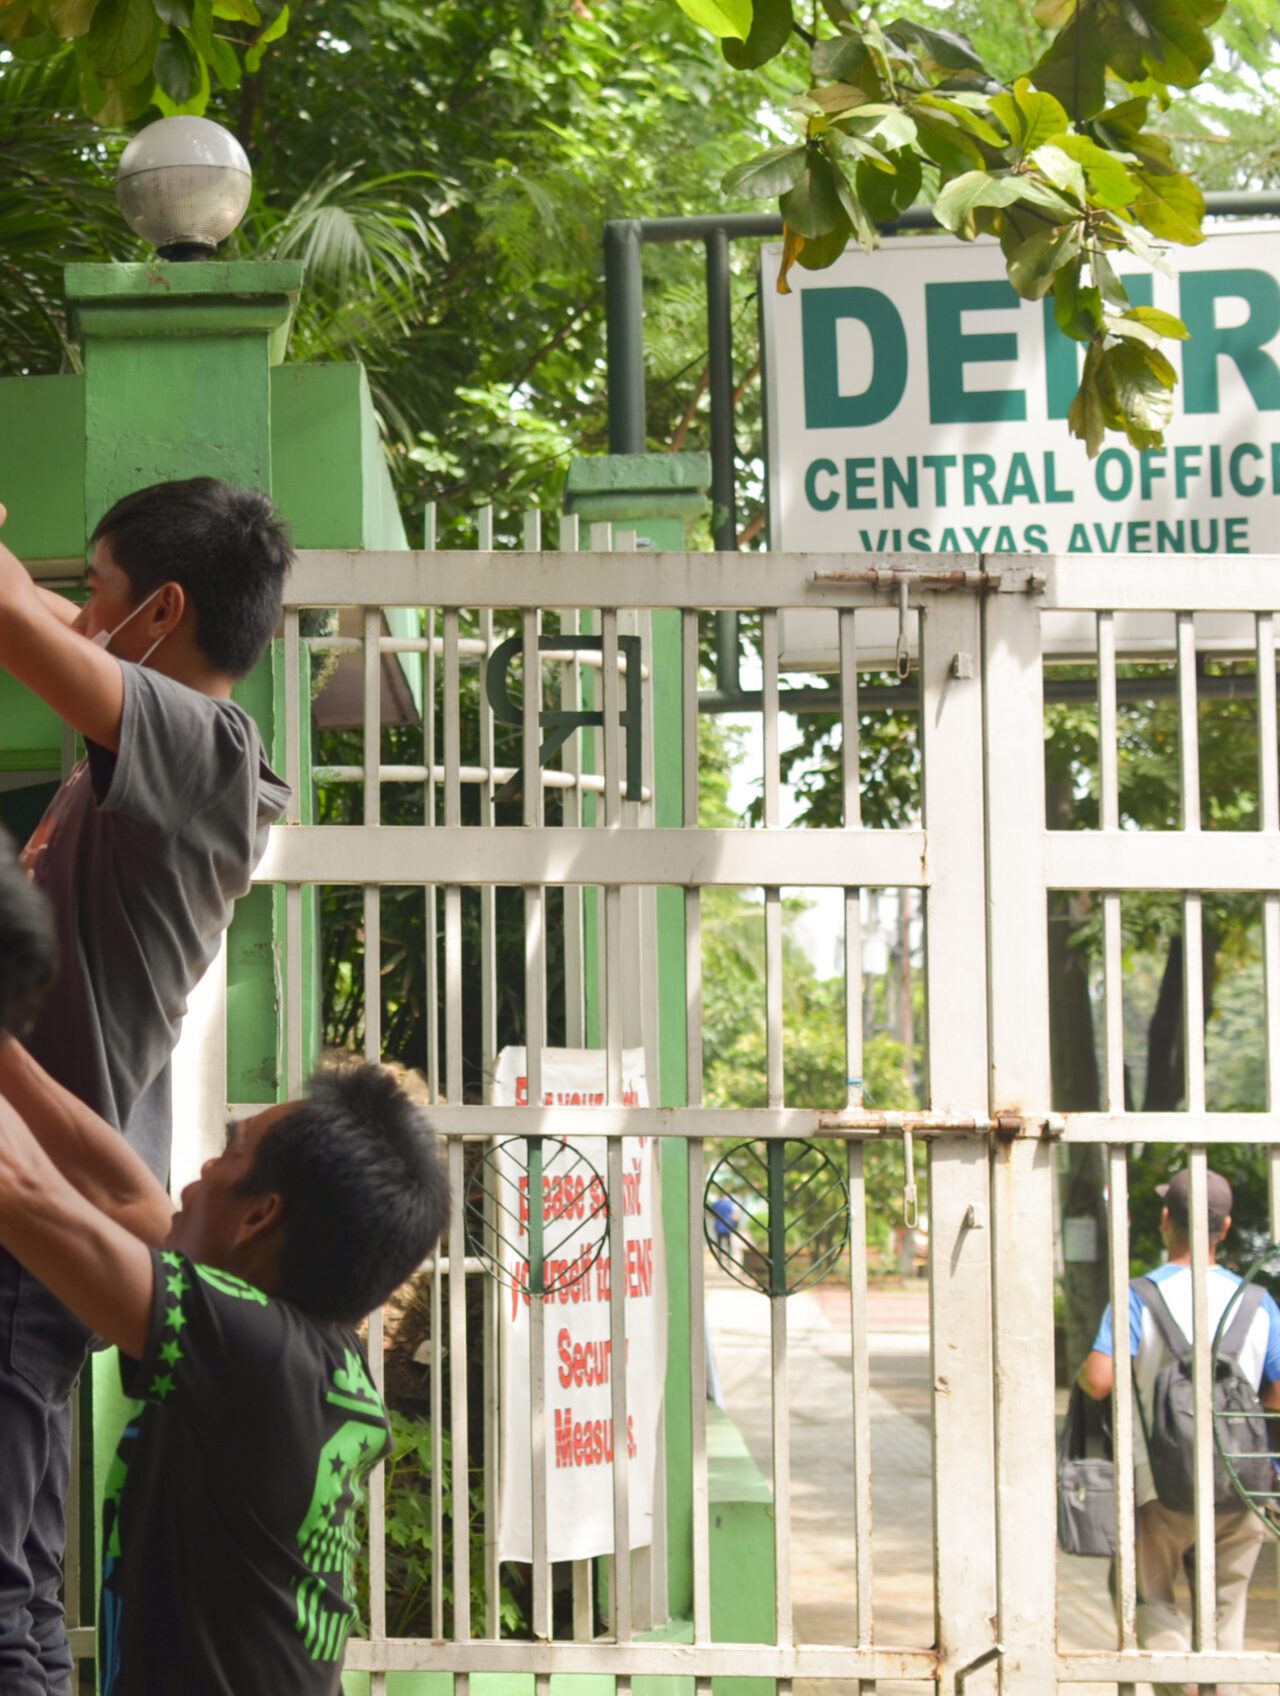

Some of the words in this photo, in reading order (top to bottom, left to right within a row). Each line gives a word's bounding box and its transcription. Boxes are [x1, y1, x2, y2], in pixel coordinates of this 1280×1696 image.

[804, 450, 1074, 512] CENTRAL
[858, 524, 1048, 553] VISAYAS
[1066, 517, 1251, 554] AVENUE
[518, 1174, 585, 1237] pease
[557, 1327, 629, 1389] Secur
[553, 1407, 638, 1469] Measus.
